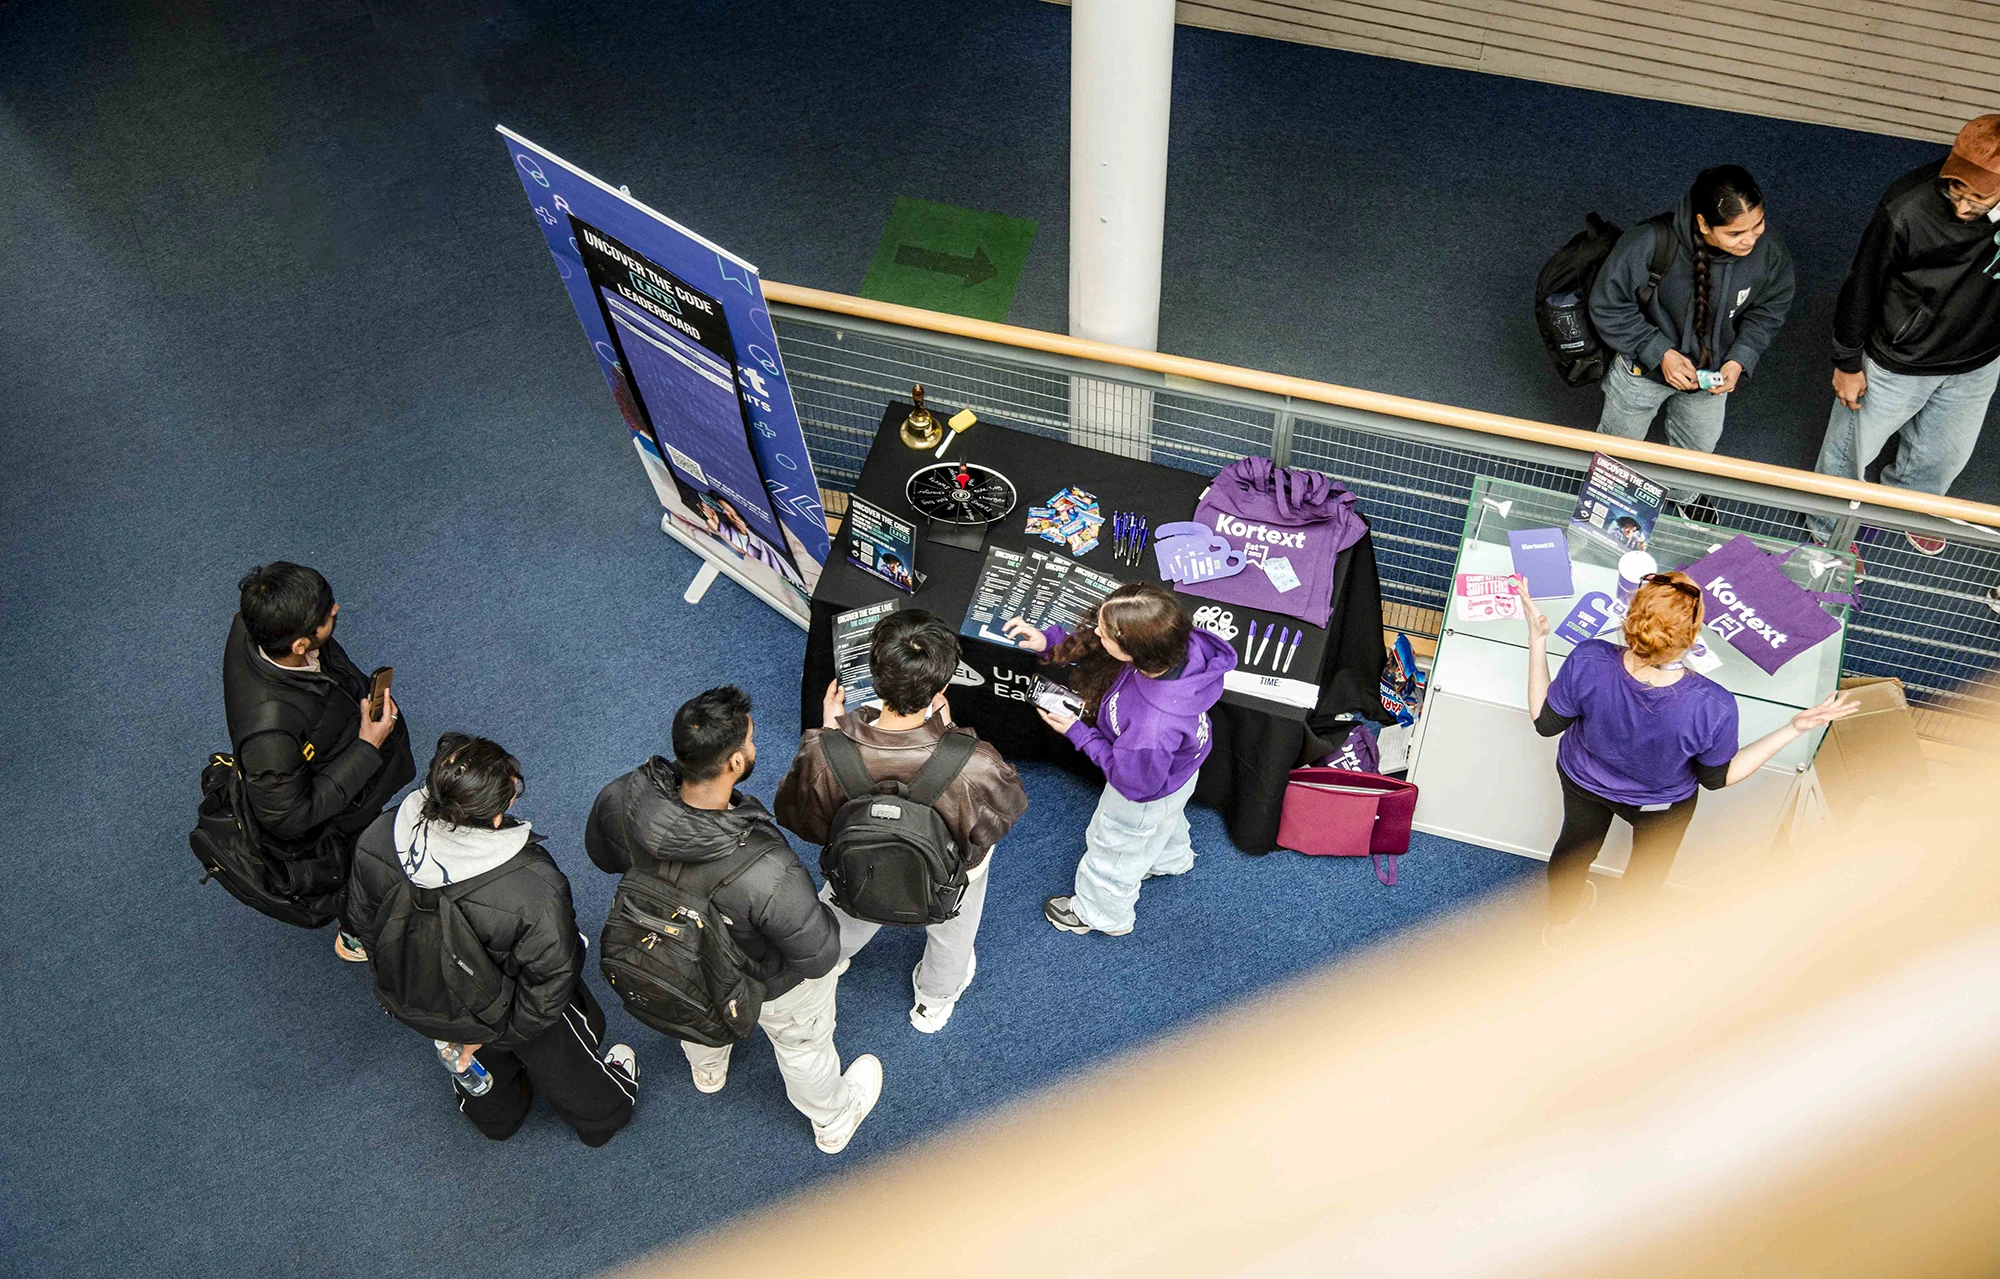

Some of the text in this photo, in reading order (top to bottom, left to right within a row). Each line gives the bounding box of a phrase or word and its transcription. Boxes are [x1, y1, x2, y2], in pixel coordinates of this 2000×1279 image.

[583, 229, 713, 315] UNCOVER THE CODE
[636, 278, 675, 307] LIVE
[617, 283, 701, 340] LEADERBOARD
[1597, 457, 1663, 498] UNCOVER THE CODE
[1637, 490, 1657, 505] LIVE
[852, 500, 881, 520] UNCOVER
[893, 521, 911, 535] CODE
[1215, 513, 1306, 549] Kortext
[1704, 575, 1788, 649] Kortext
[1260, 676, 1281, 687] TIME:
